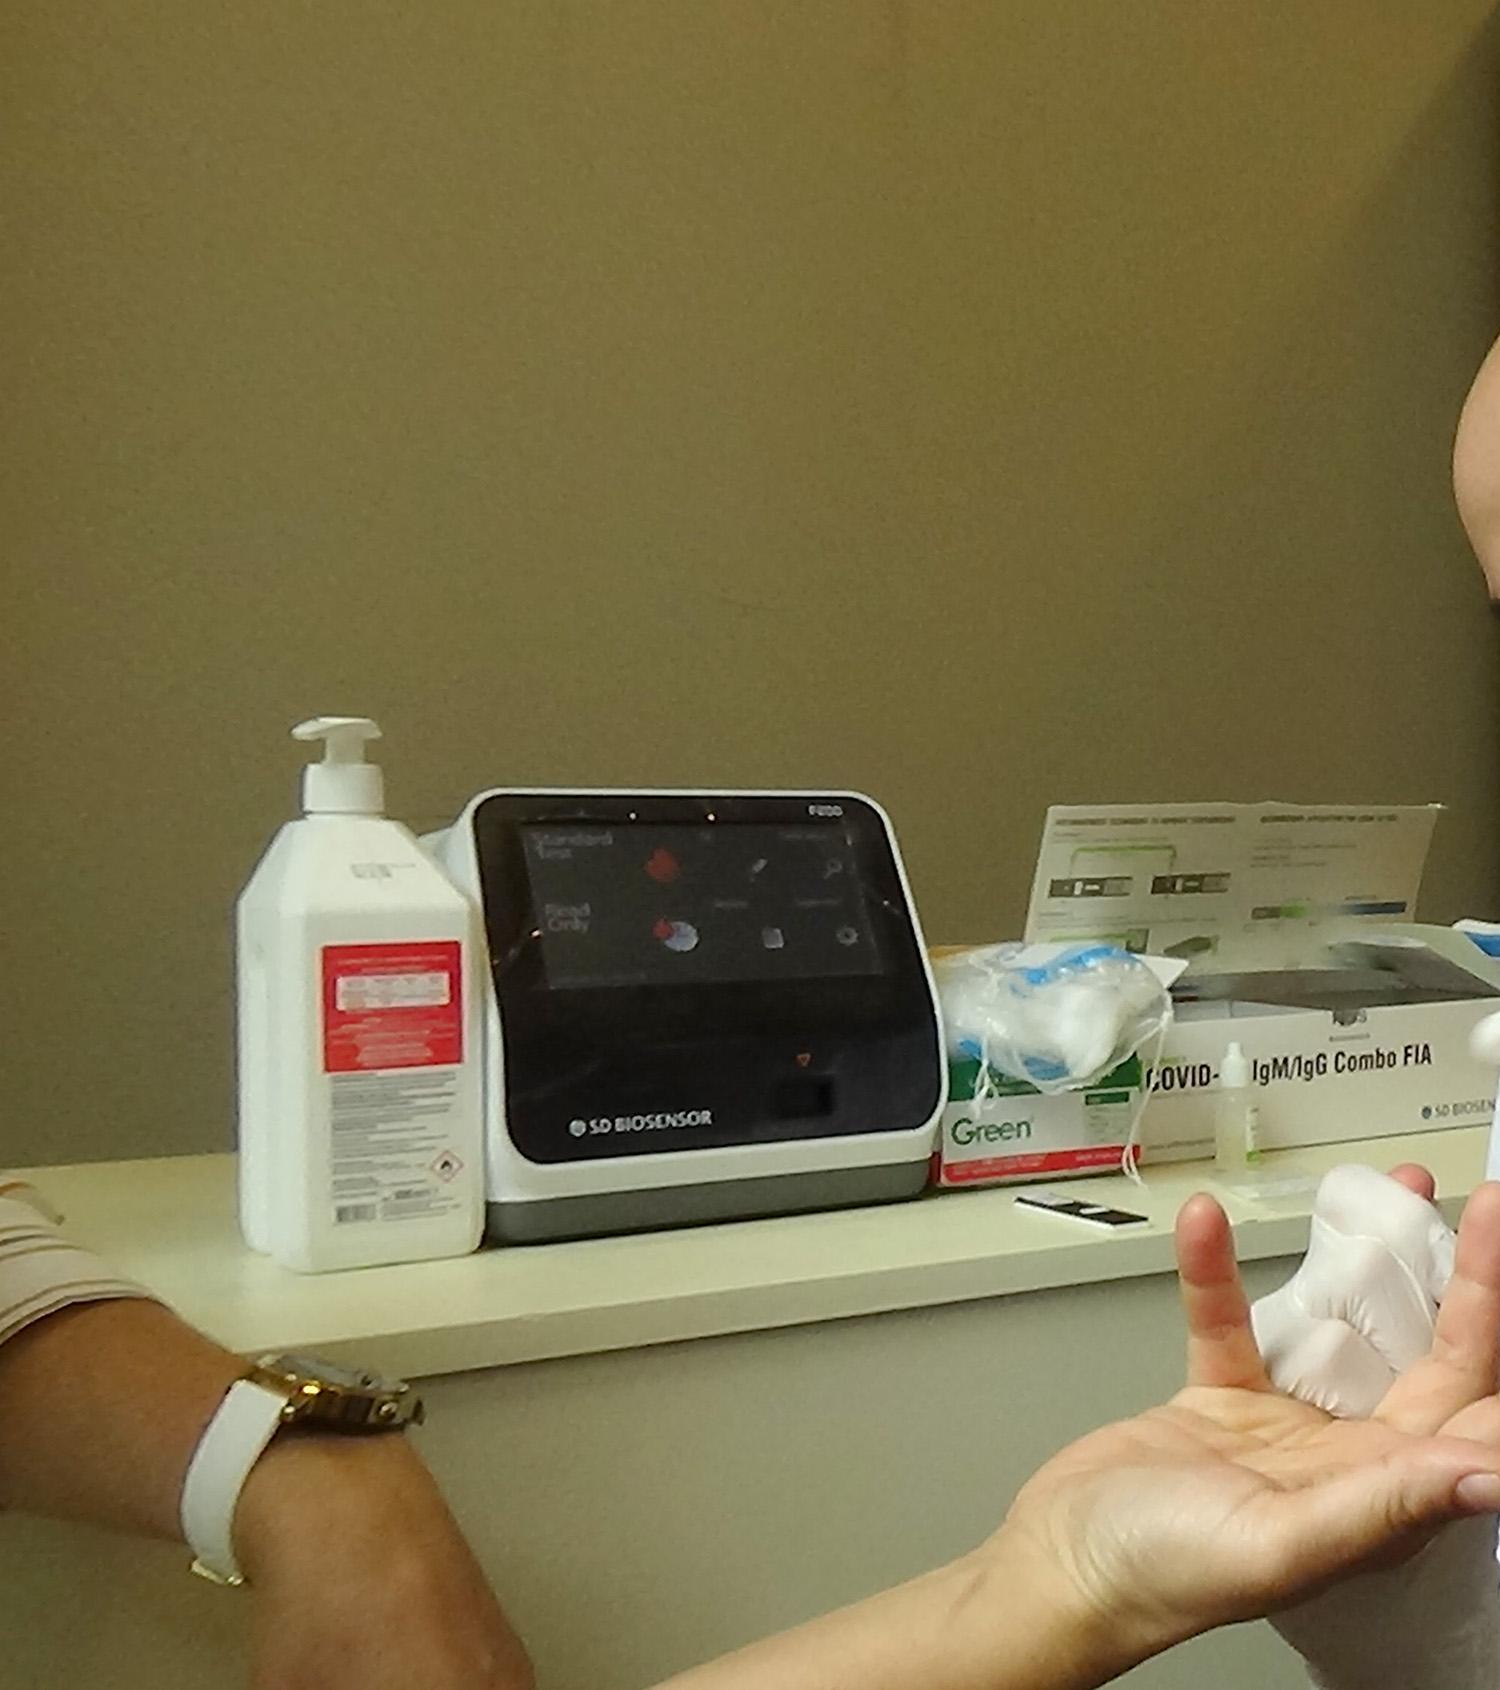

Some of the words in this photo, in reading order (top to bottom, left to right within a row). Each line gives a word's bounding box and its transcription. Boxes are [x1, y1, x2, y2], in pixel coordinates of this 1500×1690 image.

[1146, 1063, 1220, 1092] COVID-
[1252, 1053, 1328, 1087] IgM/IgG
[1334, 1047, 1397, 1075] Combo
[1403, 1042, 1433, 1067] FIA
[1452, 1099, 1497, 1116] BIOSEN
[590, 1118, 612, 1134] SD
[614, 1109, 713, 1133] BIOSENSOR
[951, 1117, 1032, 1146] Green
